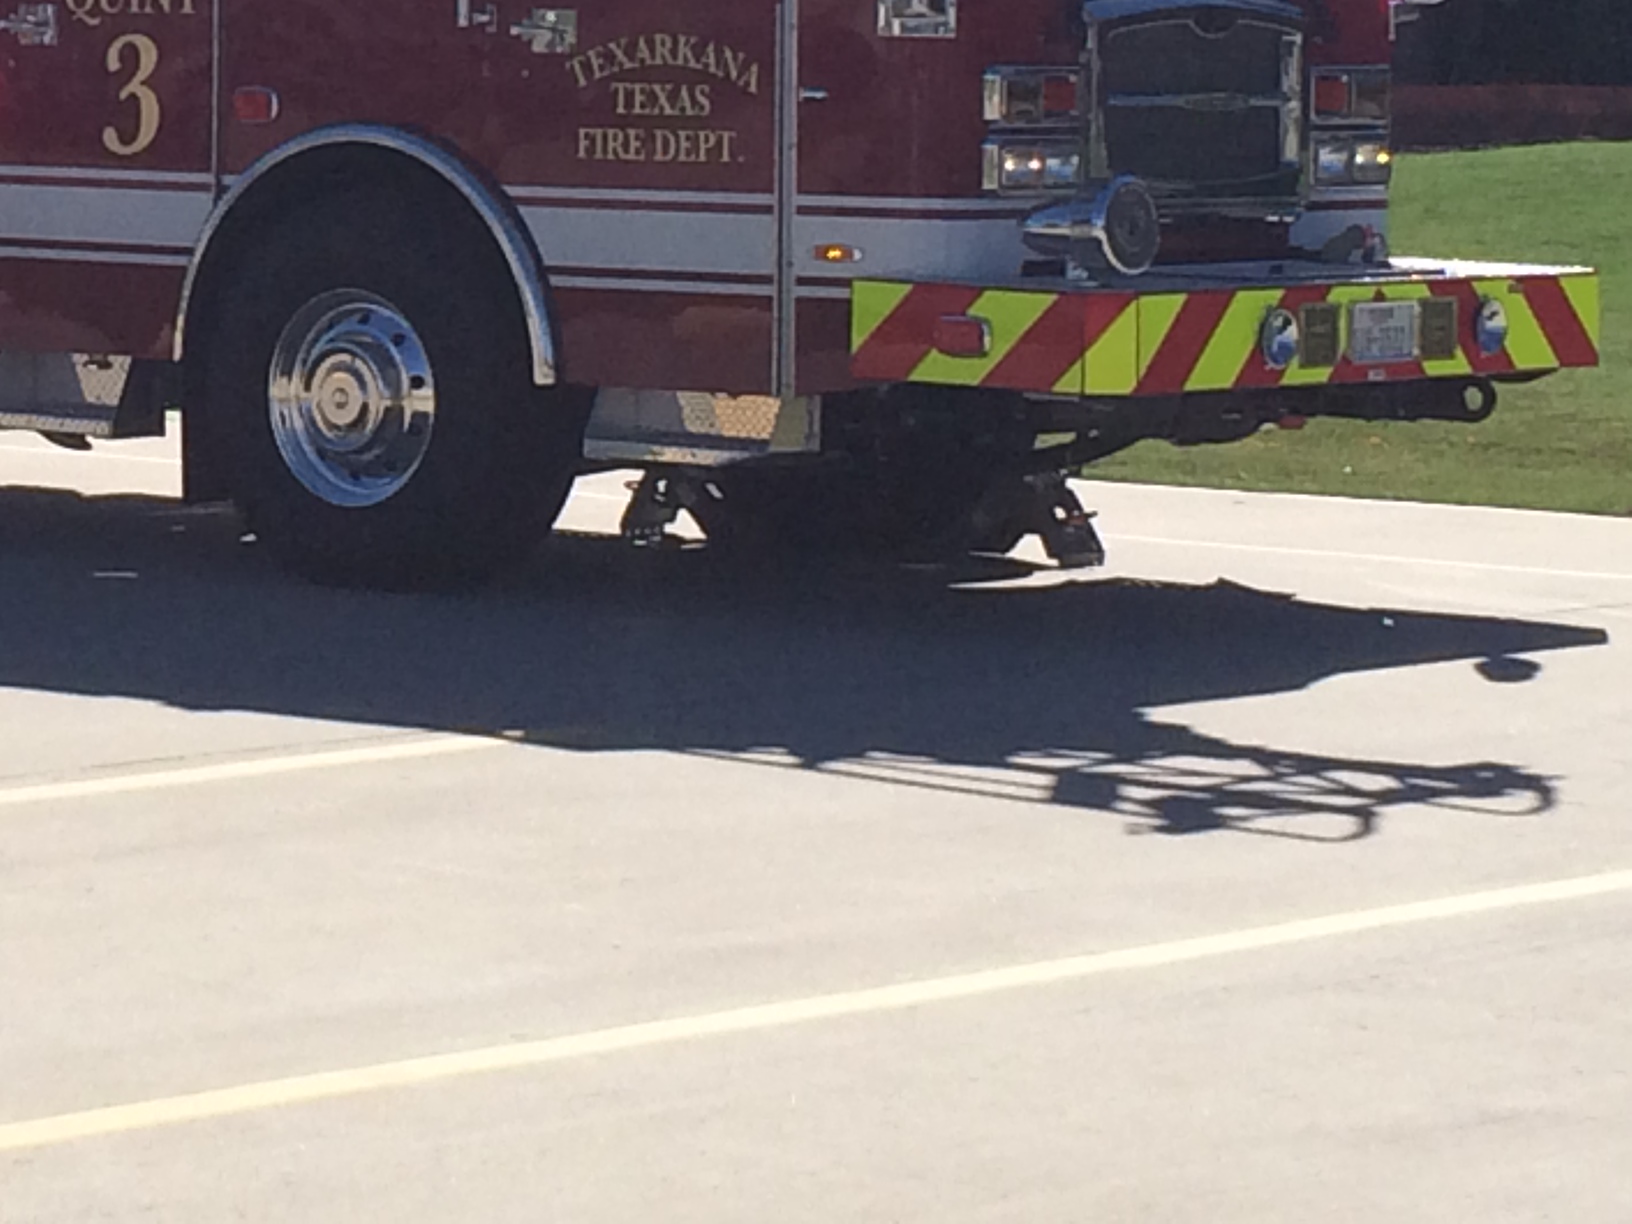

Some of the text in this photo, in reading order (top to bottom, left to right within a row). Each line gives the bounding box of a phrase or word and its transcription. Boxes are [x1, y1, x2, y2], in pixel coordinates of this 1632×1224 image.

[566, 32, 760, 95] TEXARKANA
[102, 32, 161, 156] 3
[610, 81, 712, 116] TEXAS
[577, 127, 745, 163] FIRE DEPT.
